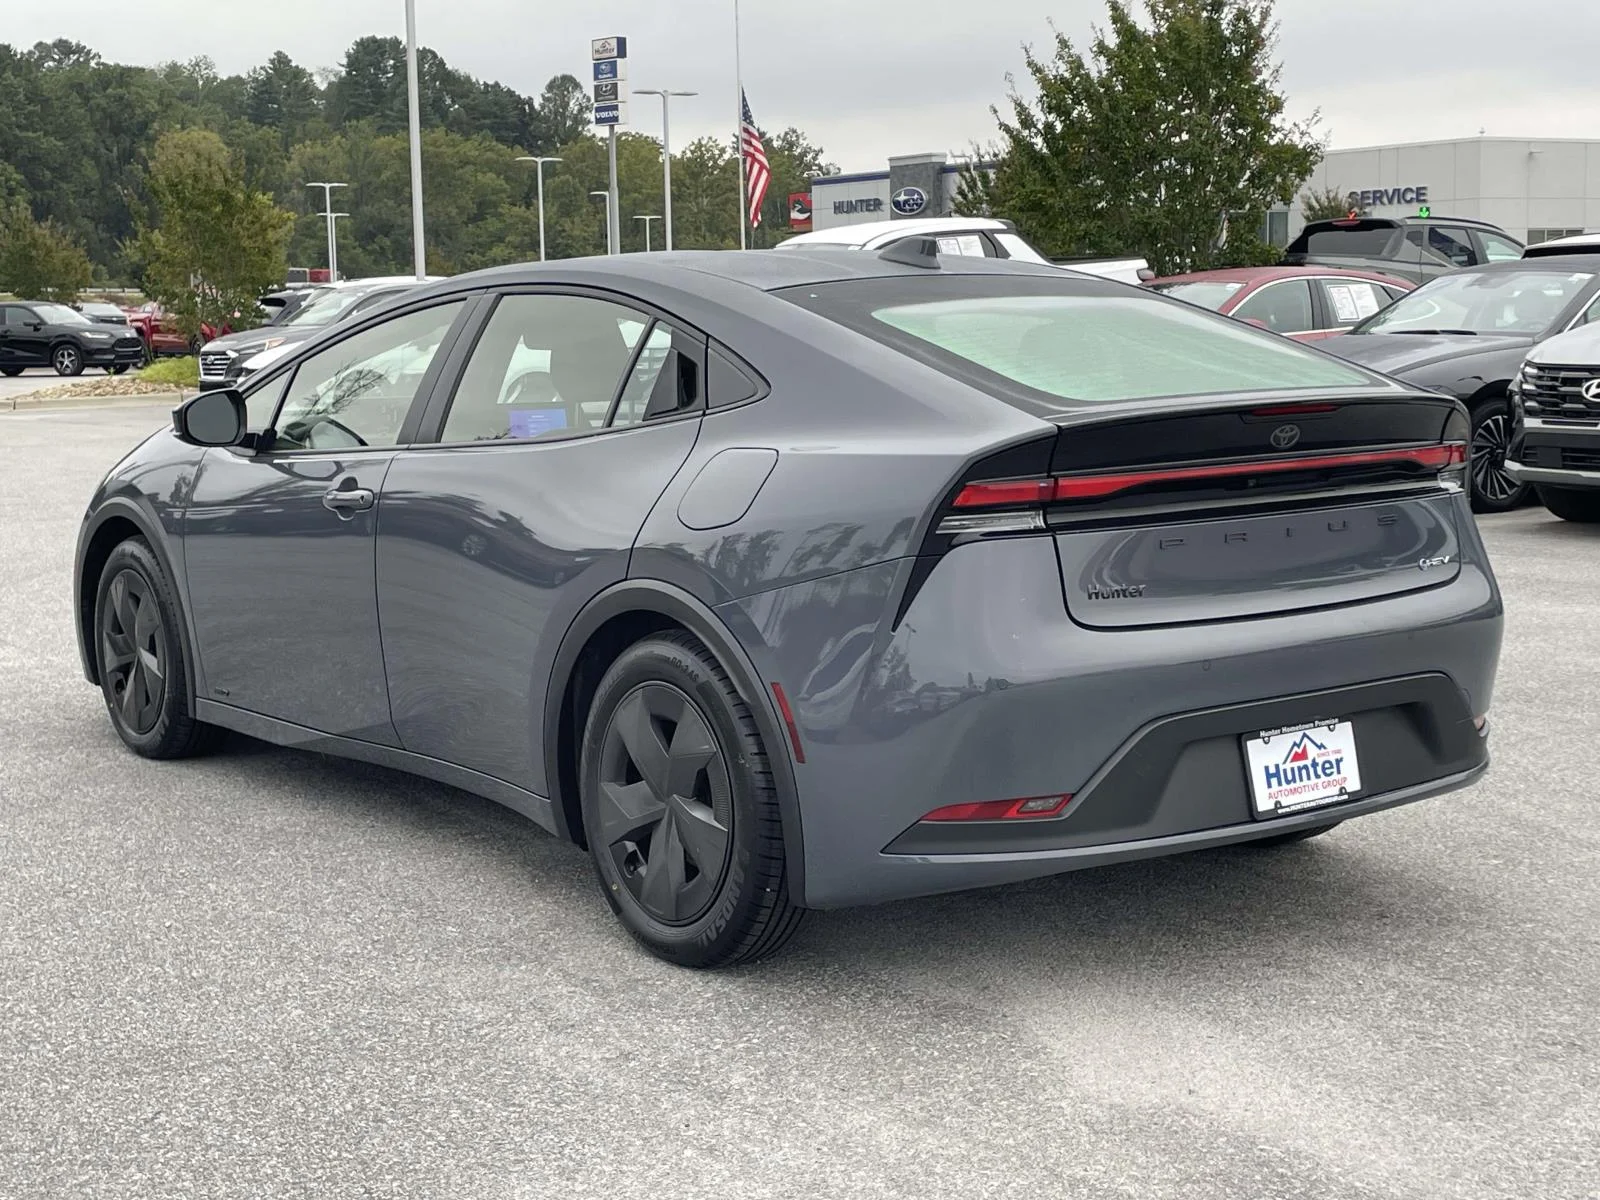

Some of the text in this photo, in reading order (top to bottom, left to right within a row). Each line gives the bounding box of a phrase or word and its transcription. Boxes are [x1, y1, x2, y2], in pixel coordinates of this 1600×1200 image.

[833, 197, 884, 214] HUNTER
[1347, 186, 1428, 206] SERVICE
[1160, 513, 1397, 550] PRIUS
[1087, 583, 1146, 600] Hunter
[1264, 756, 1344, 789] Hunter
[1268, 777, 1347, 800] AUTOMOTIVE GROUP
